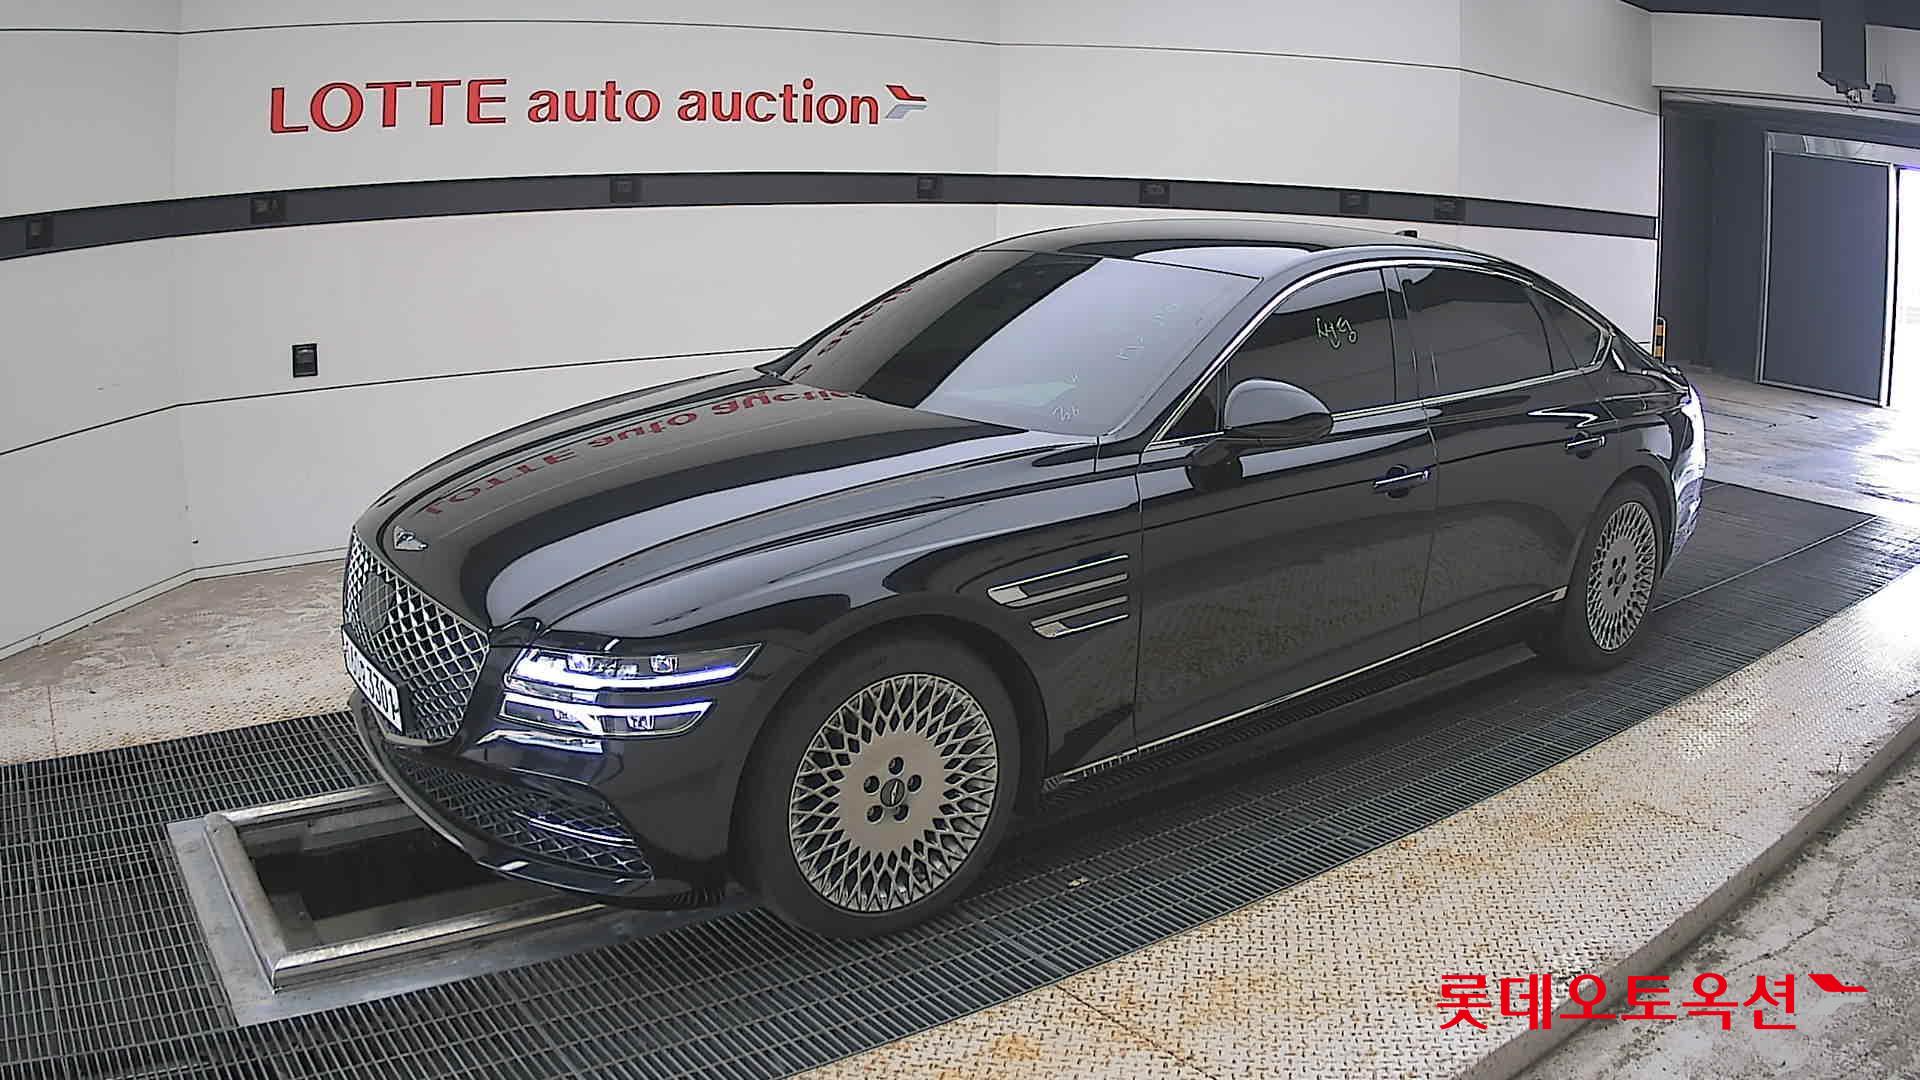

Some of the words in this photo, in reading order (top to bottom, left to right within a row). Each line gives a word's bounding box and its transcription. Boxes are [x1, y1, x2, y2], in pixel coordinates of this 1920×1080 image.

[269, 78, 508, 133] LOTTE
[527, 79, 661, 123] auto
[676, 77, 880, 126] auction
